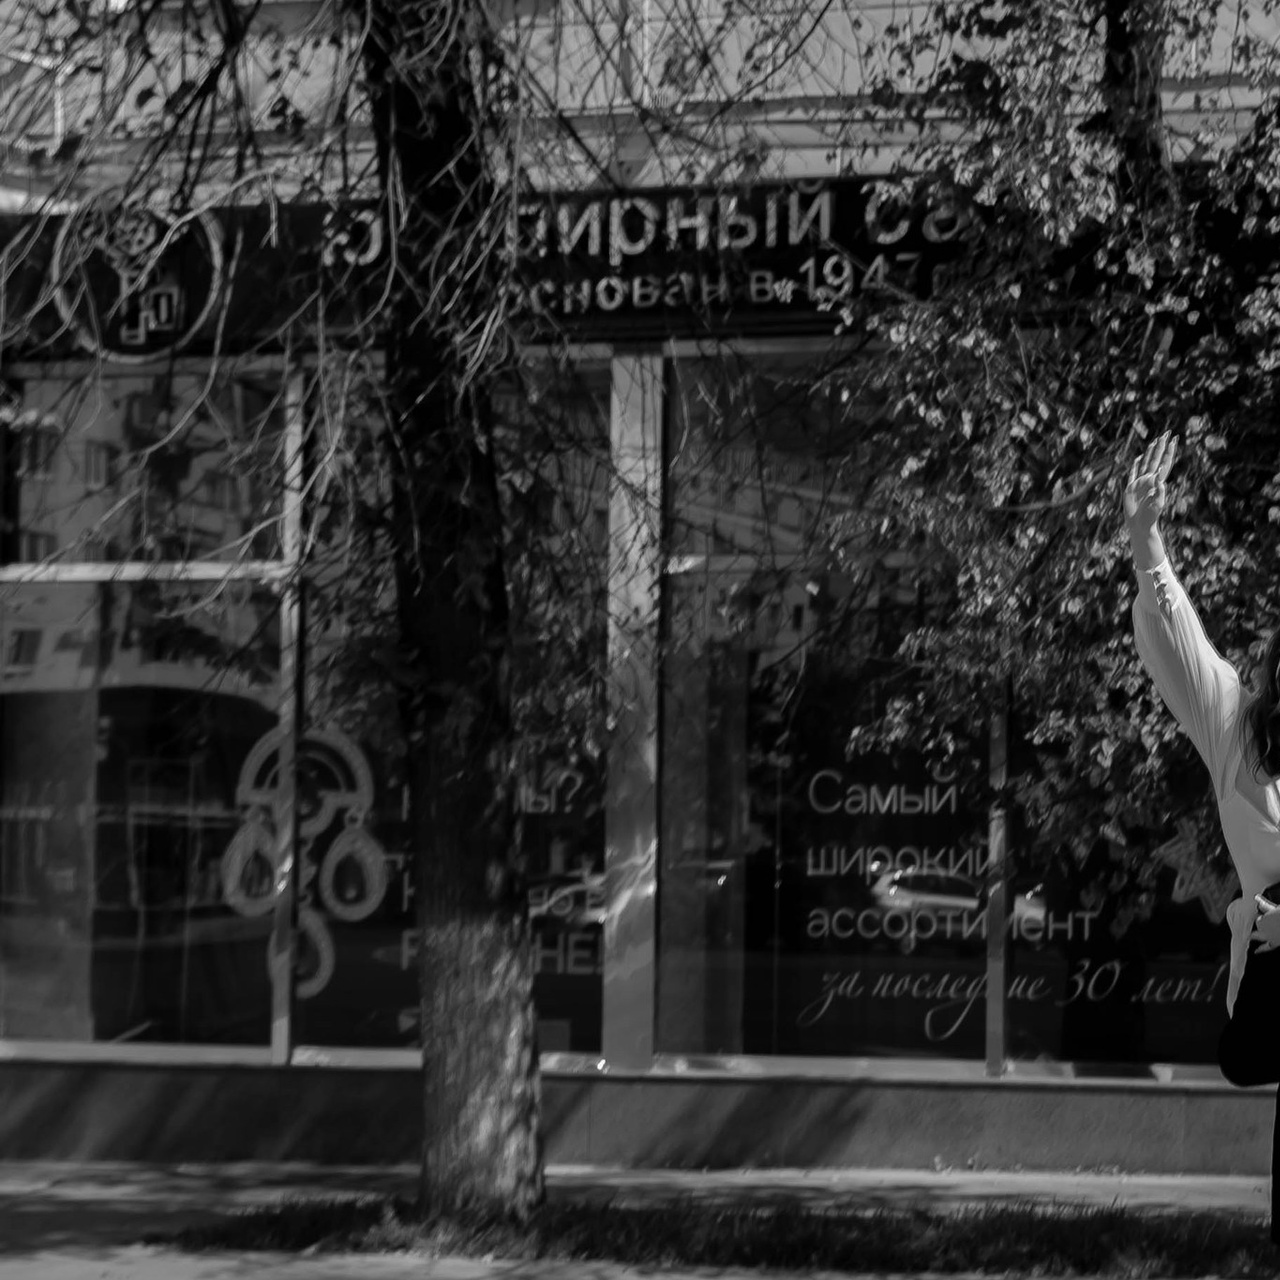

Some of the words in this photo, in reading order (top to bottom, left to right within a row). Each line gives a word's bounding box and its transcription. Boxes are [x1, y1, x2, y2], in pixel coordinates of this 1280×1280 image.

[748, 269, 776, 304] в
[808, 766, 957, 816] Самый
[796, 969, 864, 1028] за
[872, 968, 1050, 1042] последие
[1055, 955, 1128, 1008] 30
[1129, 961, 1228, 1005] лет!
